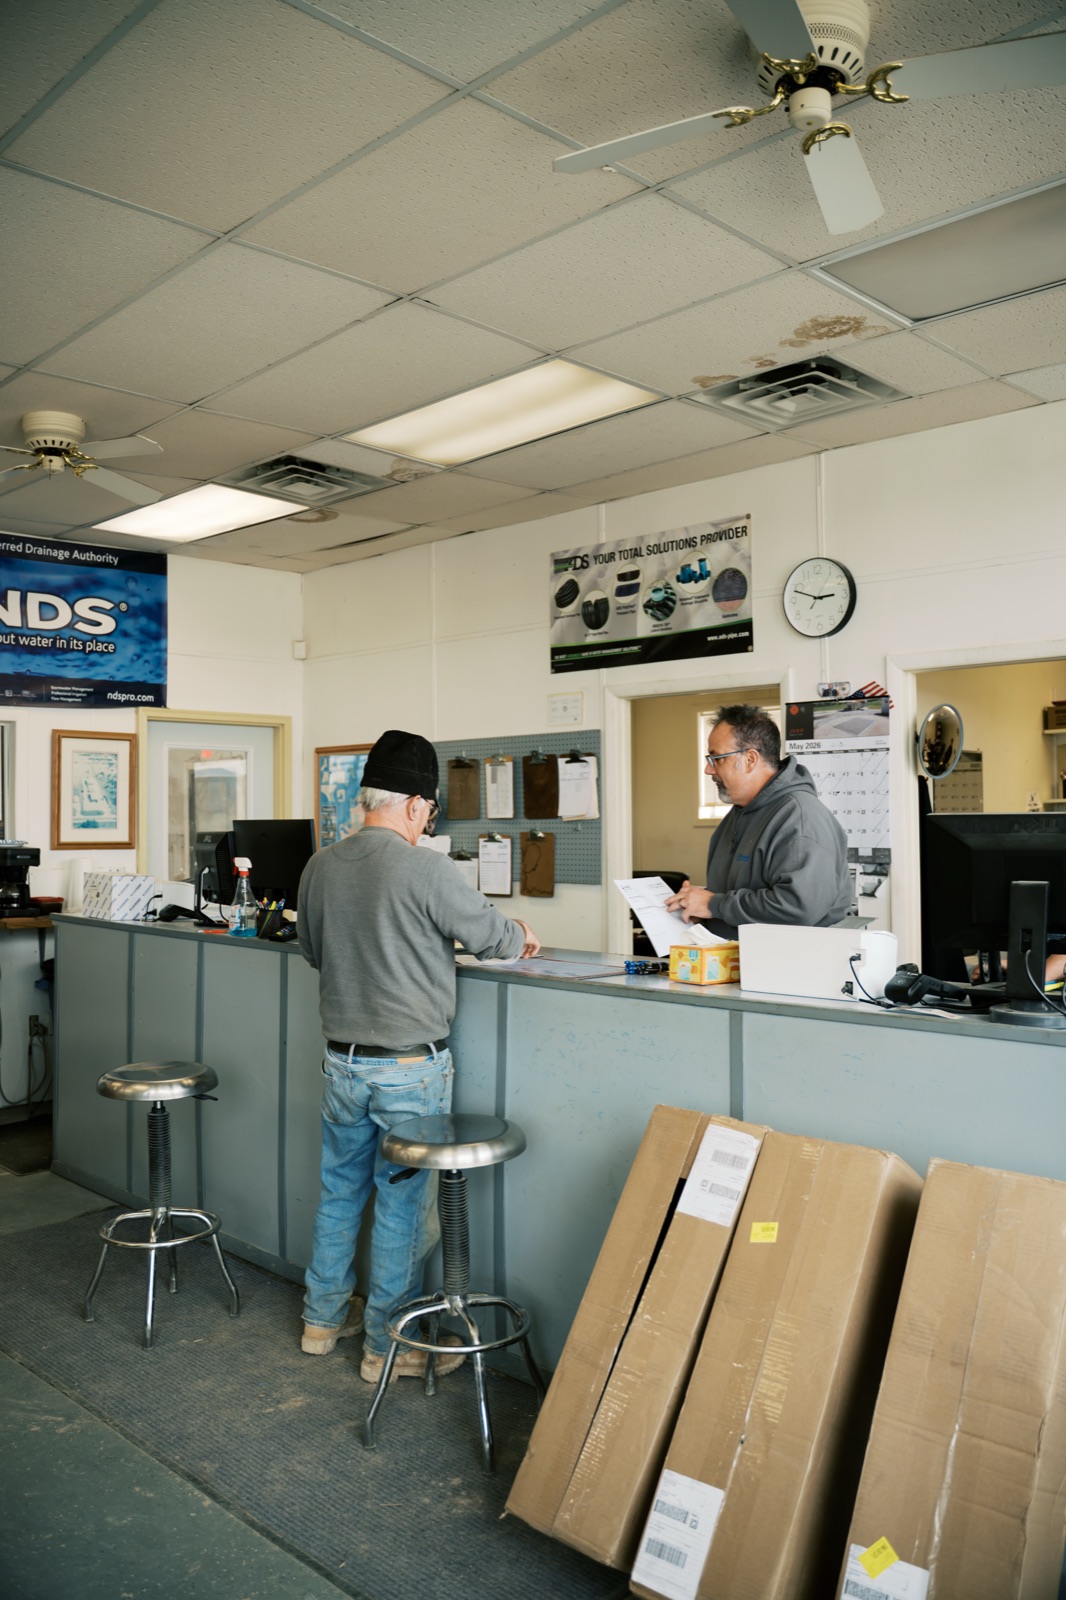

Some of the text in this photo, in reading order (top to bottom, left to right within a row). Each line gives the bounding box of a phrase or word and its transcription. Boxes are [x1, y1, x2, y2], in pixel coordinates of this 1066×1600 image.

[593, 554, 616, 565] YOUR
[619, 547, 645, 561] TOTAL
[646, 536, 698, 556] SOLUTIONS
[700, 525, 748, 546] PROVIDER
[0, 542, 119, 565] rred Drainage Authority
[813, 564, 822, 575] 12
[836, 574, 844, 586] 2
[841, 588, 849, 600] 3
[790, 596, 798, 606] 9
[837, 603, 844, 614] 4
[795, 610, 802, 621] 8
[828, 615, 836, 626] 5
[805, 618, 812, 629] 7
[816, 622, 824, 632] 6
[18, 635, 54, 648] water
[56, 636, 67, 648] in
[70, 637, 83, 650] its
[85, 639, 115, 653] place
[107, 690, 155, 703] ndspro.com
[789, 741, 822, 751] May 2026
